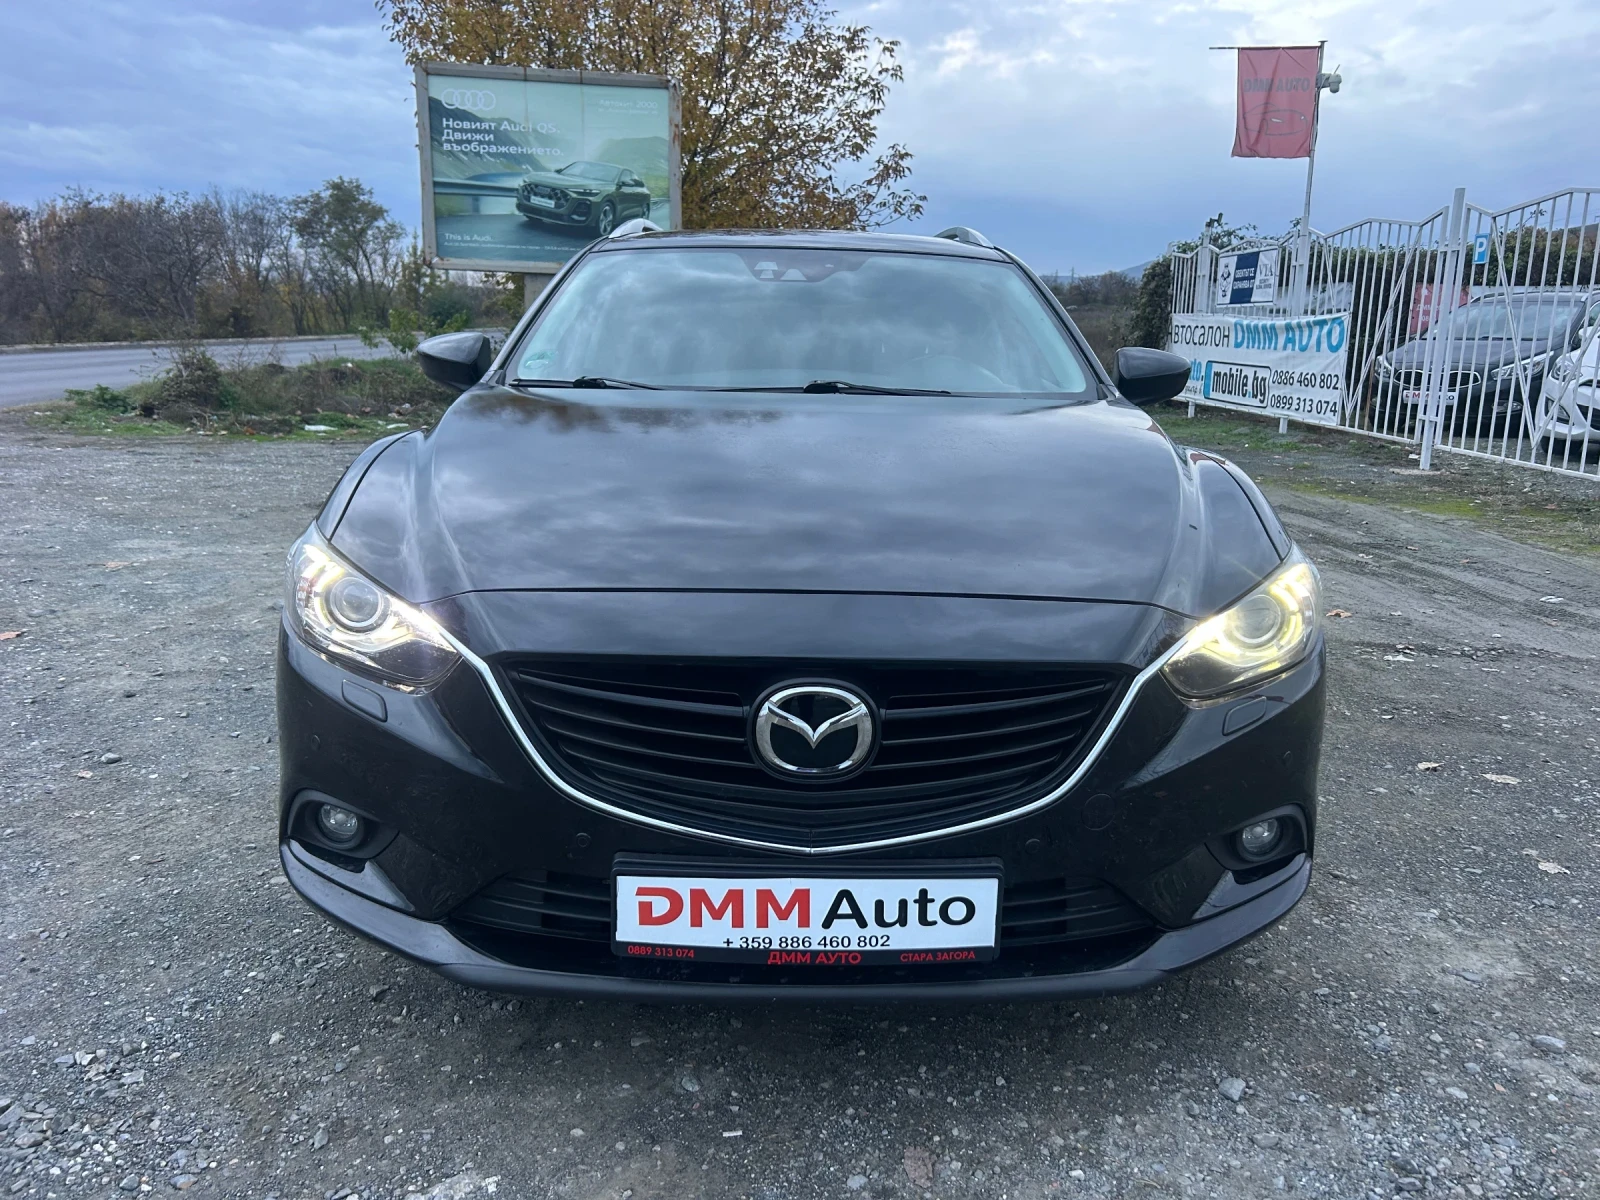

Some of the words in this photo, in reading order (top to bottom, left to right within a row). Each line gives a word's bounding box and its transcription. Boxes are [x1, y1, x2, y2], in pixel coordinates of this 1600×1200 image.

[1275, 77, 1311, 92] AUTO
[442, 117, 496, 130] Новият
[500, 120, 532, 133] Audi
[442, 129, 495, 142] Движи
[443, 142, 564, 156] въображението.
[444, 232, 462, 241] This
[463, 233, 471, 241] is
[1475, 237, 1487, 261] P
[1234, 319, 1279, 350] DMM
[1282, 316, 1345, 353] AUTO
[1211, 367, 1267, 404] mobile.bg
[1271, 370, 1295, 386] 0886
[1296, 371, 1317, 388] 460
[1318, 373, 1340, 390] 802
[1270, 394, 1294, 410] 0899
[1294, 397, 1314, 413] 313
[1315, 400, 1338, 417] 074
[635, 886, 811, 929] DMM
[821, 887, 976, 930] Auto
[739, 936, 773, 949] 359
[778, 936, 812, 949] 886
[817, 936, 851, 948] 460
[856, 934, 890, 947] 802
[627, 945, 652, 955] 0889
[655, 947, 674, 957] 313
[675, 948, 695, 959] 074
[767, 951, 811, 965] ДММ
[815, 951, 862, 965] АУТО
[900, 952, 933, 962] СТАРА
[936, 951, 975, 961] ЗАГОРА
